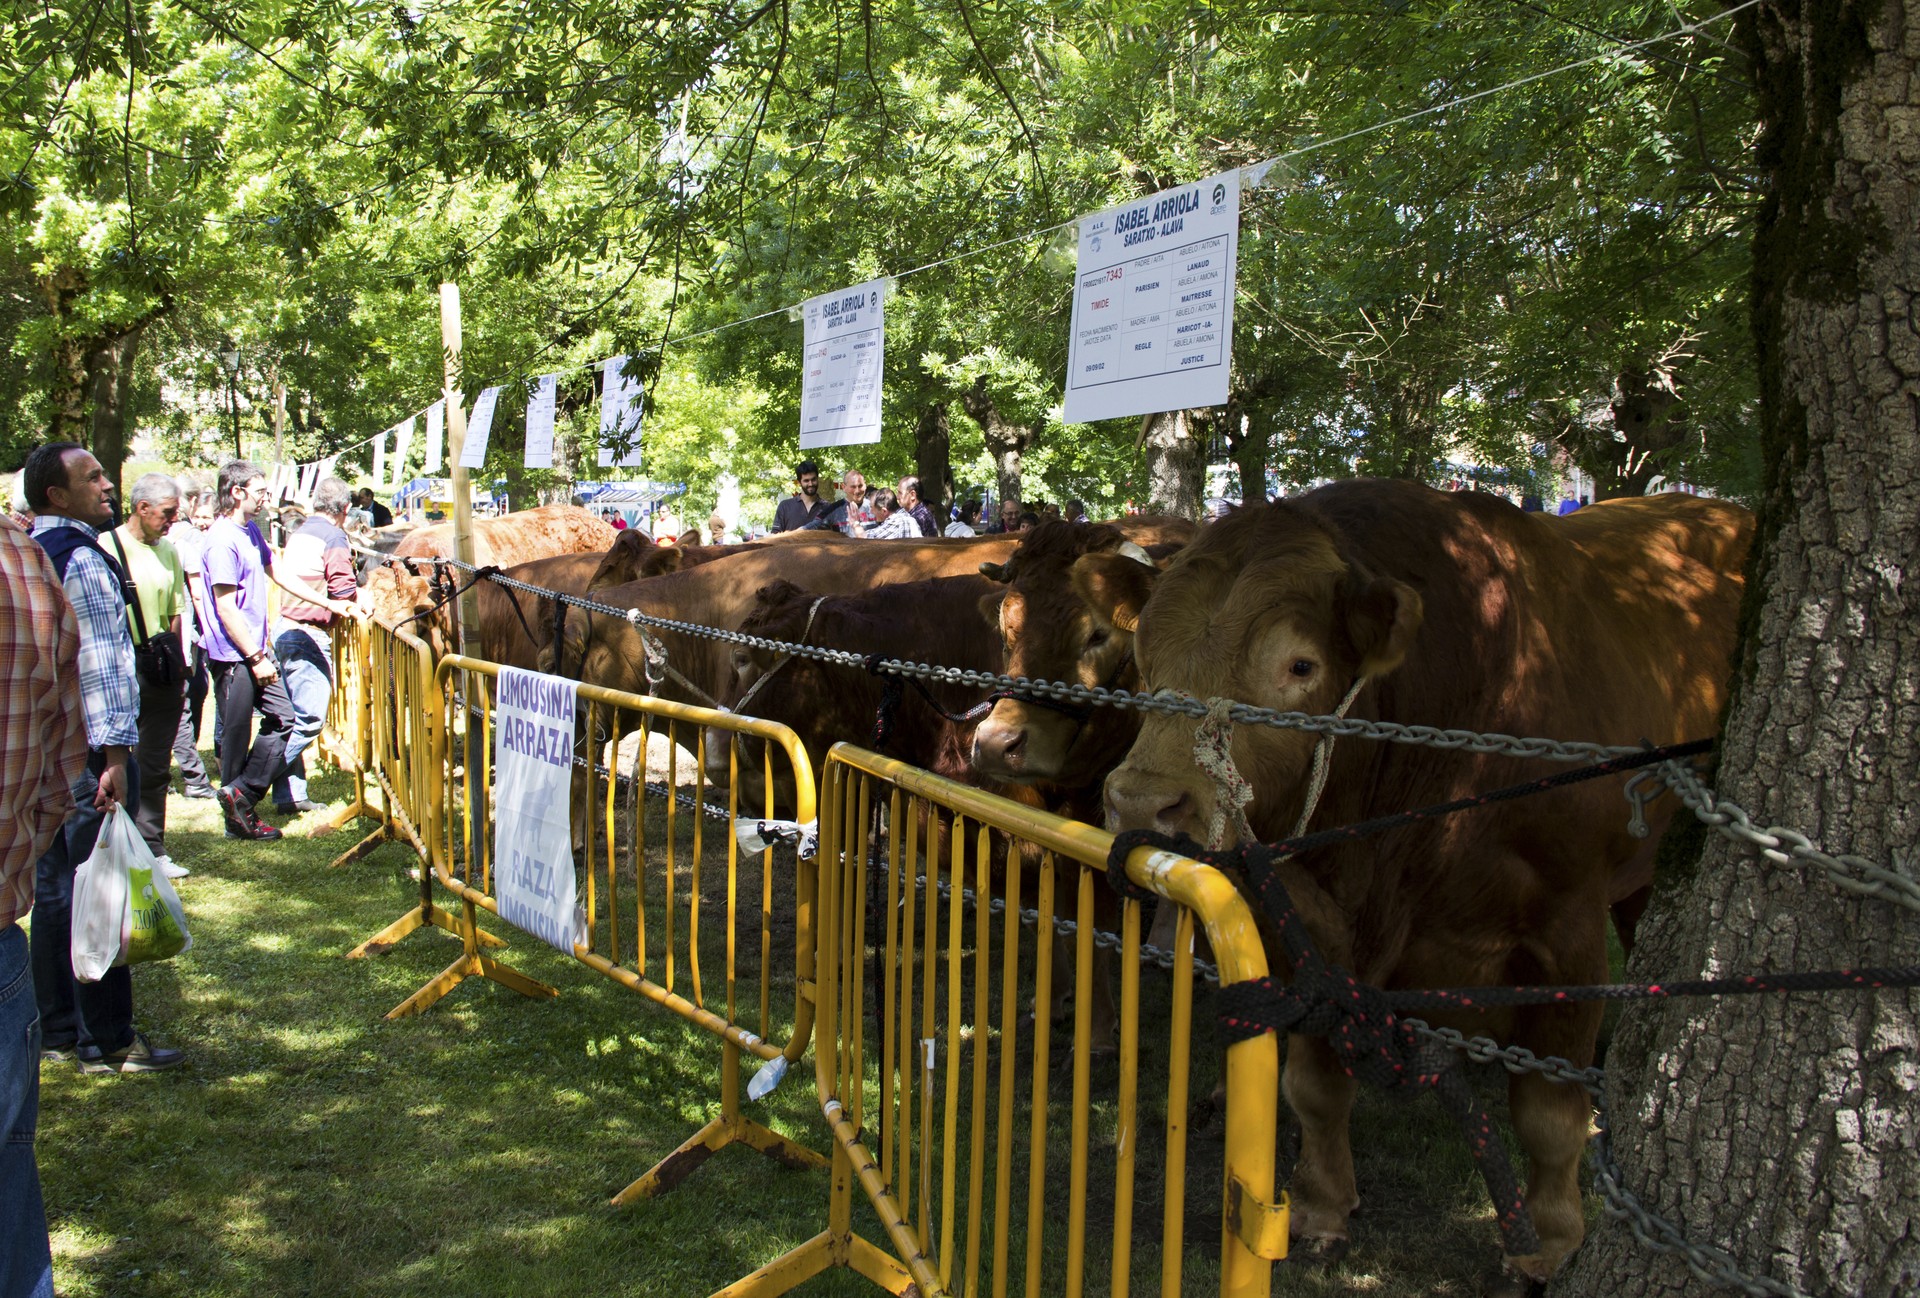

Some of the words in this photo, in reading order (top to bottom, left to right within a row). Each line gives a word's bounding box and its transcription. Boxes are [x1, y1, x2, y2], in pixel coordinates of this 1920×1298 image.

[1114, 206, 1149, 235] ISABEL
[1152, 189, 1199, 223] ARRIOLA
[1124, 226, 1155, 247] SARATXO
[1161, 218, 1183, 237] ALAVA
[1187, 259, 1210, 271] LANAUD
[1106, 267, 1123, 282] 7343
[1135, 282, 1160, 293] PARISIEN
[1181, 289, 1212, 302] MAITRESSE
[823, 301, 840, 319] ISABEL
[841, 293, 865, 314] ARRIOLA
[1177, 323, 1201, 334] HARICOT
[1134, 342, 1152, 351] REGLE
[1181, 355, 1204, 365] JUSTICE
[501, 670, 573, 723] LIMOUSINA
[503, 715, 571, 770] ARRAZA
[512, 849, 557, 904] RAZA
